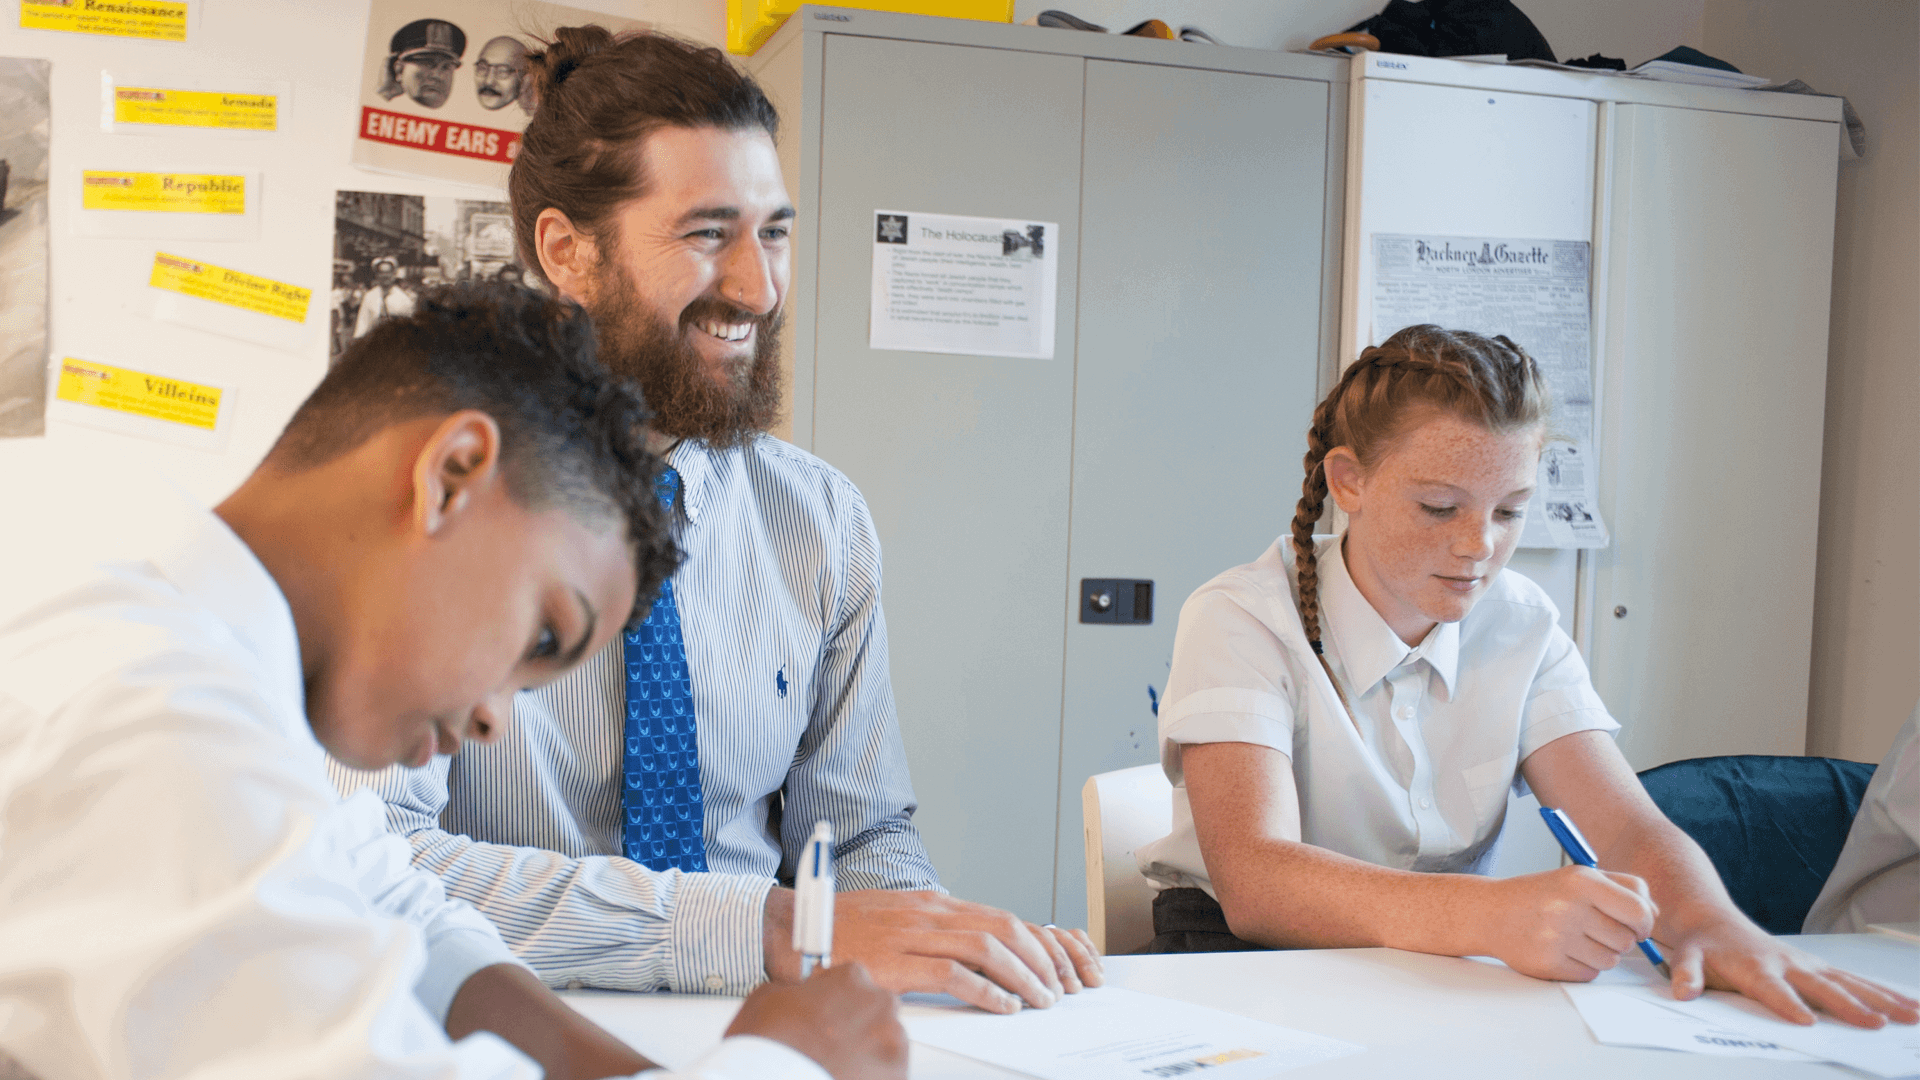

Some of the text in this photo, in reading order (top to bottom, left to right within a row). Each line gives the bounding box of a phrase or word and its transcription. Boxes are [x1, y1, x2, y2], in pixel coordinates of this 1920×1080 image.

[85, 0, 185, 18] Renaissance
[366, 112, 441, 146] ENEMY
[445, 126, 500, 156] EARS
[162, 176, 241, 196] Republic
[921, 227, 943, 240] The
[1415, 239, 1479, 266] Hackney
[1493, 243, 1550, 265] Gazette
[223, 270, 308, 300] Divine Right
[145, 377, 217, 406] Villeins
